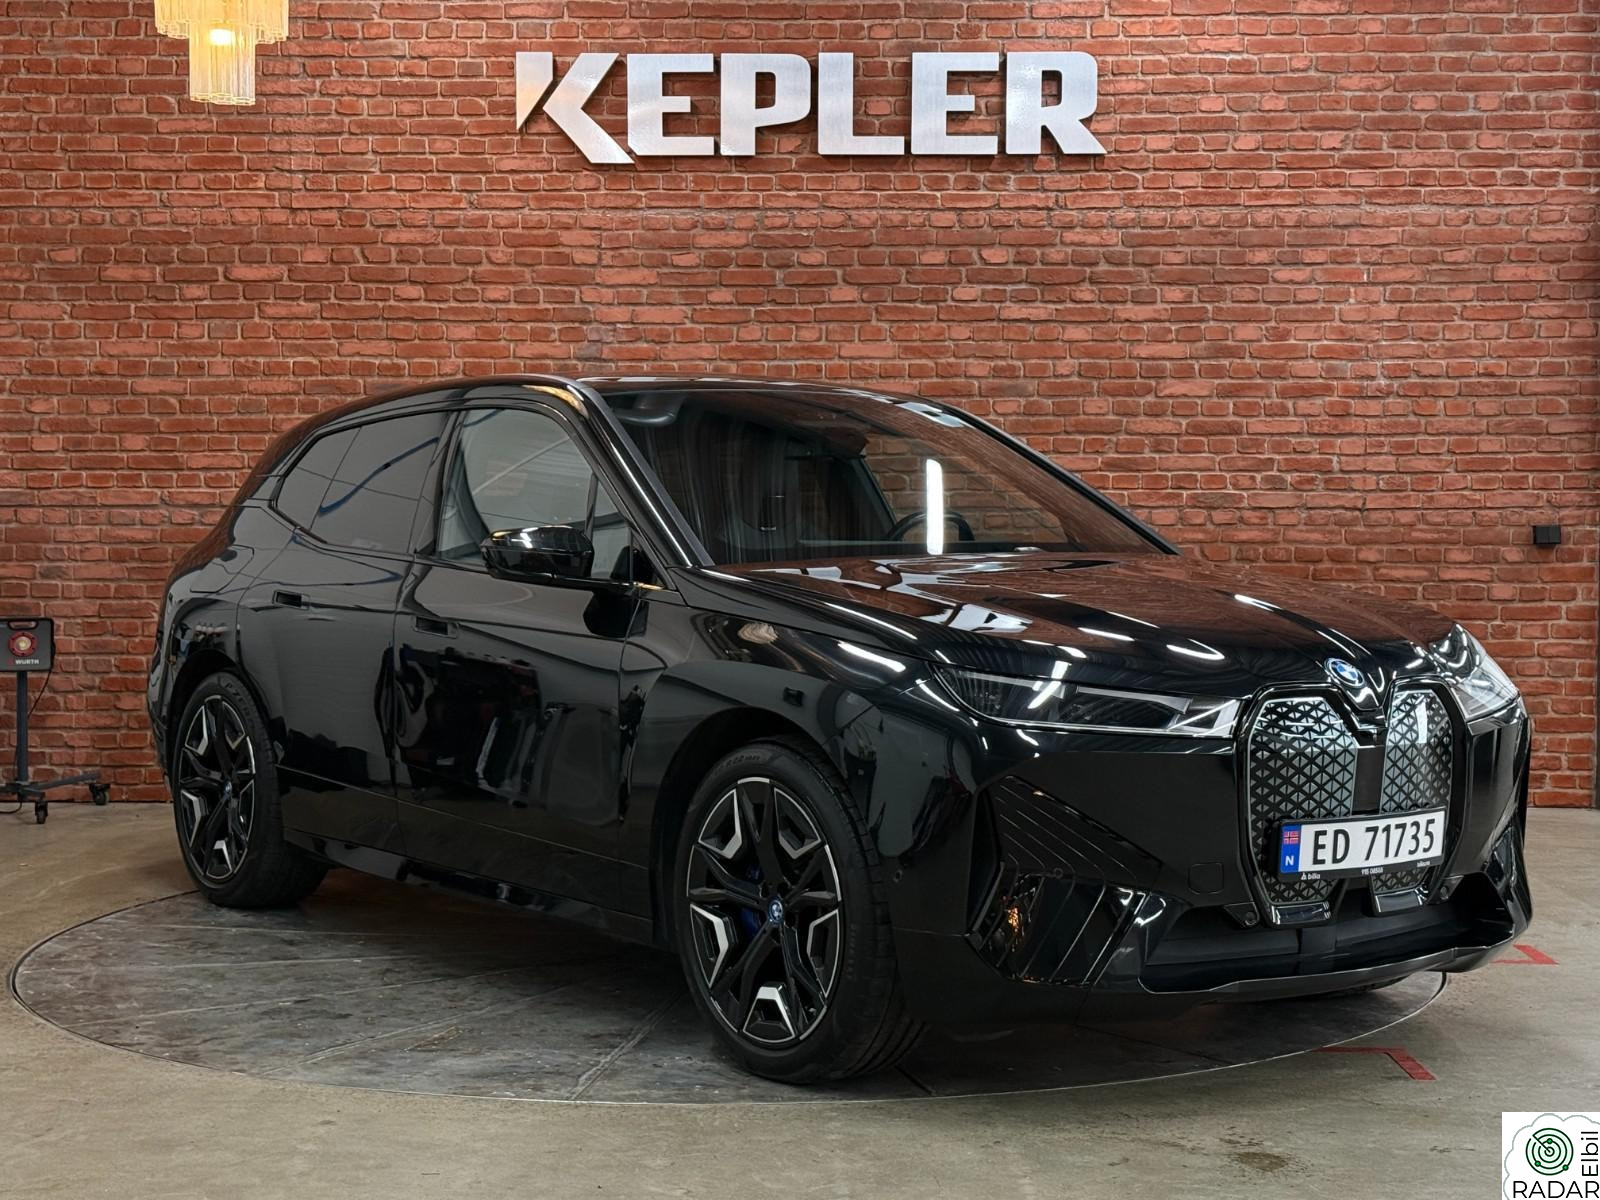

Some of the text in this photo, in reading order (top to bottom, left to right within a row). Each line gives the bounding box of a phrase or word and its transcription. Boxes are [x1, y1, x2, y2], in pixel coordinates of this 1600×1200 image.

[515, 51, 1107, 164] KEPLER
[1285, 855, 1295, 867] N
[1312, 818, 1435, 865] ED 71735
